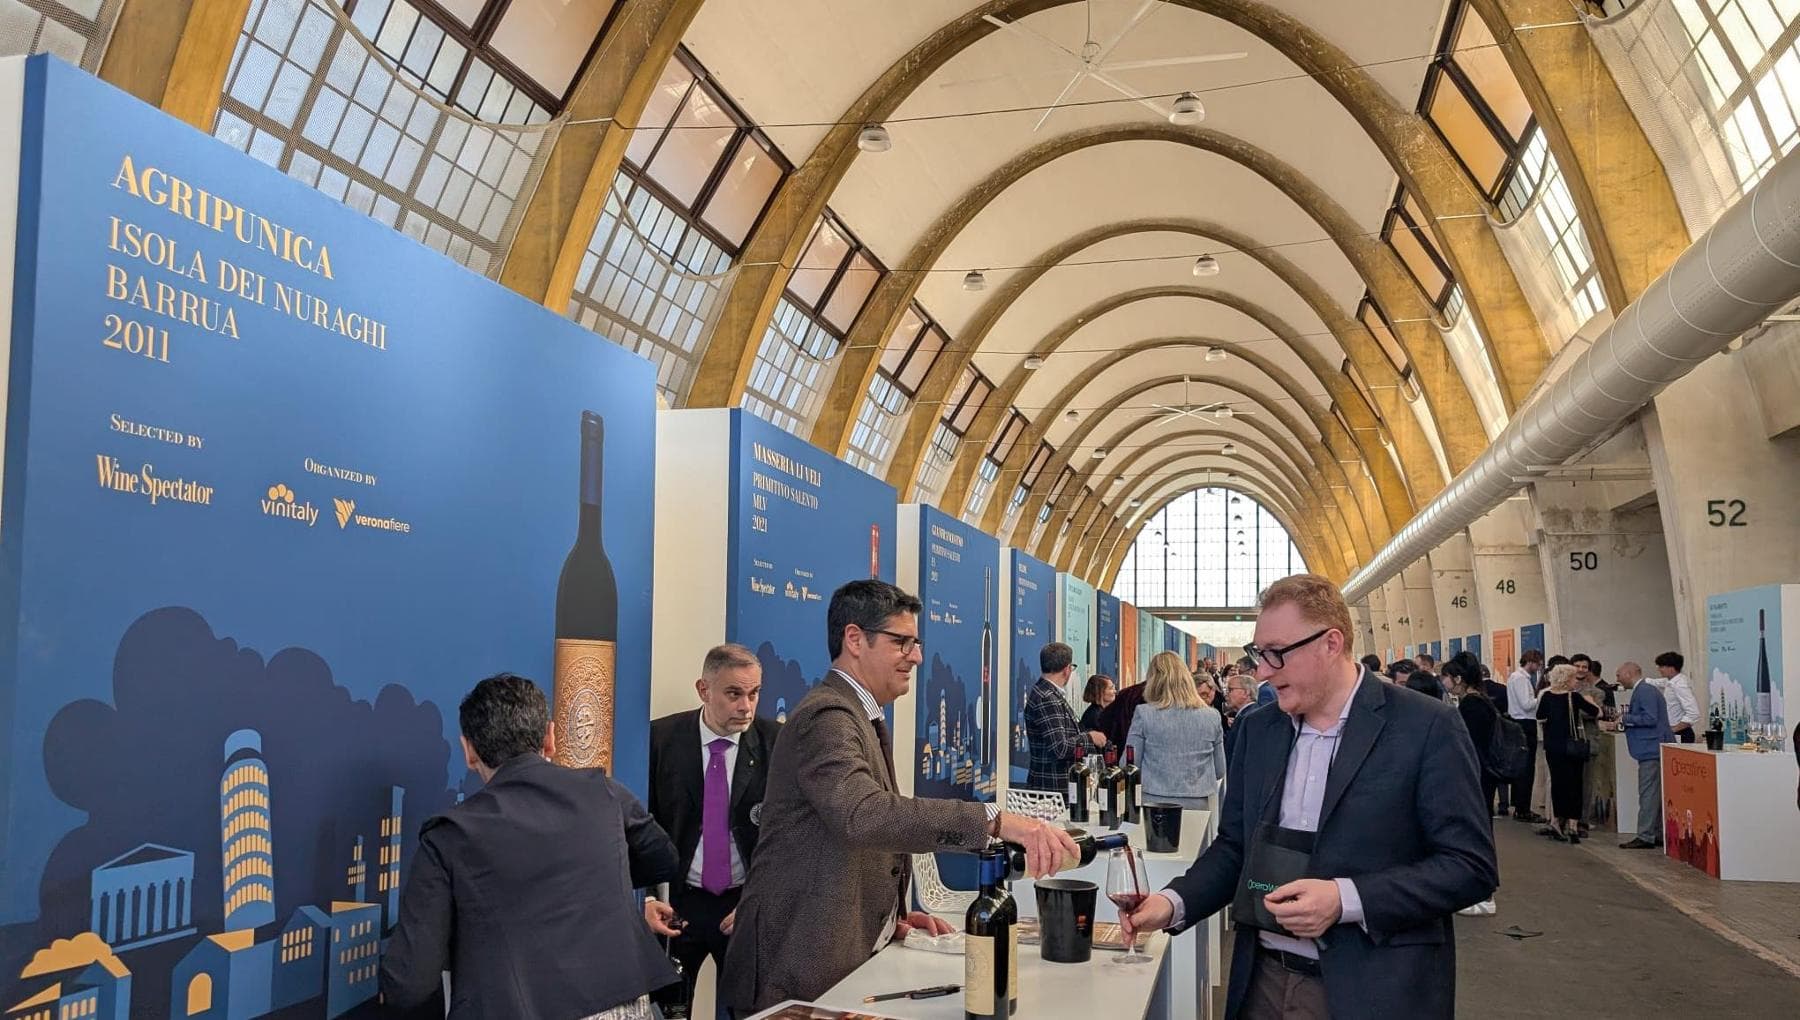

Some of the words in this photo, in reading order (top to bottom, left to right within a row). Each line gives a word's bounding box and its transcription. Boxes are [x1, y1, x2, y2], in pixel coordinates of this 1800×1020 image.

[110, 155, 334, 280] AGRIPUNICA
[108, 216, 208, 284] ISOLA
[217, 260, 267, 305] DEI
[273, 282, 387, 350] NURAGHI
[106, 264, 240, 339] BARRUA
[102, 314, 170, 363] 2011
[752, 442, 794, 476] MASSERIA
[97, 454, 139, 493] Wine
[141, 463, 214, 505] Spectator
[752, 471, 790, 499] PRIMITIVO
[791, 487, 819, 510] SALENTO
[261, 499, 319, 527] vinitaly
[355, 514, 410, 533] veronafiere
[1707, 499, 1747, 527] 52
[1570, 552, 1598, 571] 50
[1451, 596, 1468, 608] 46
[1496, 579, 1516, 594] 48
[1398, 617, 1410, 626] 44
